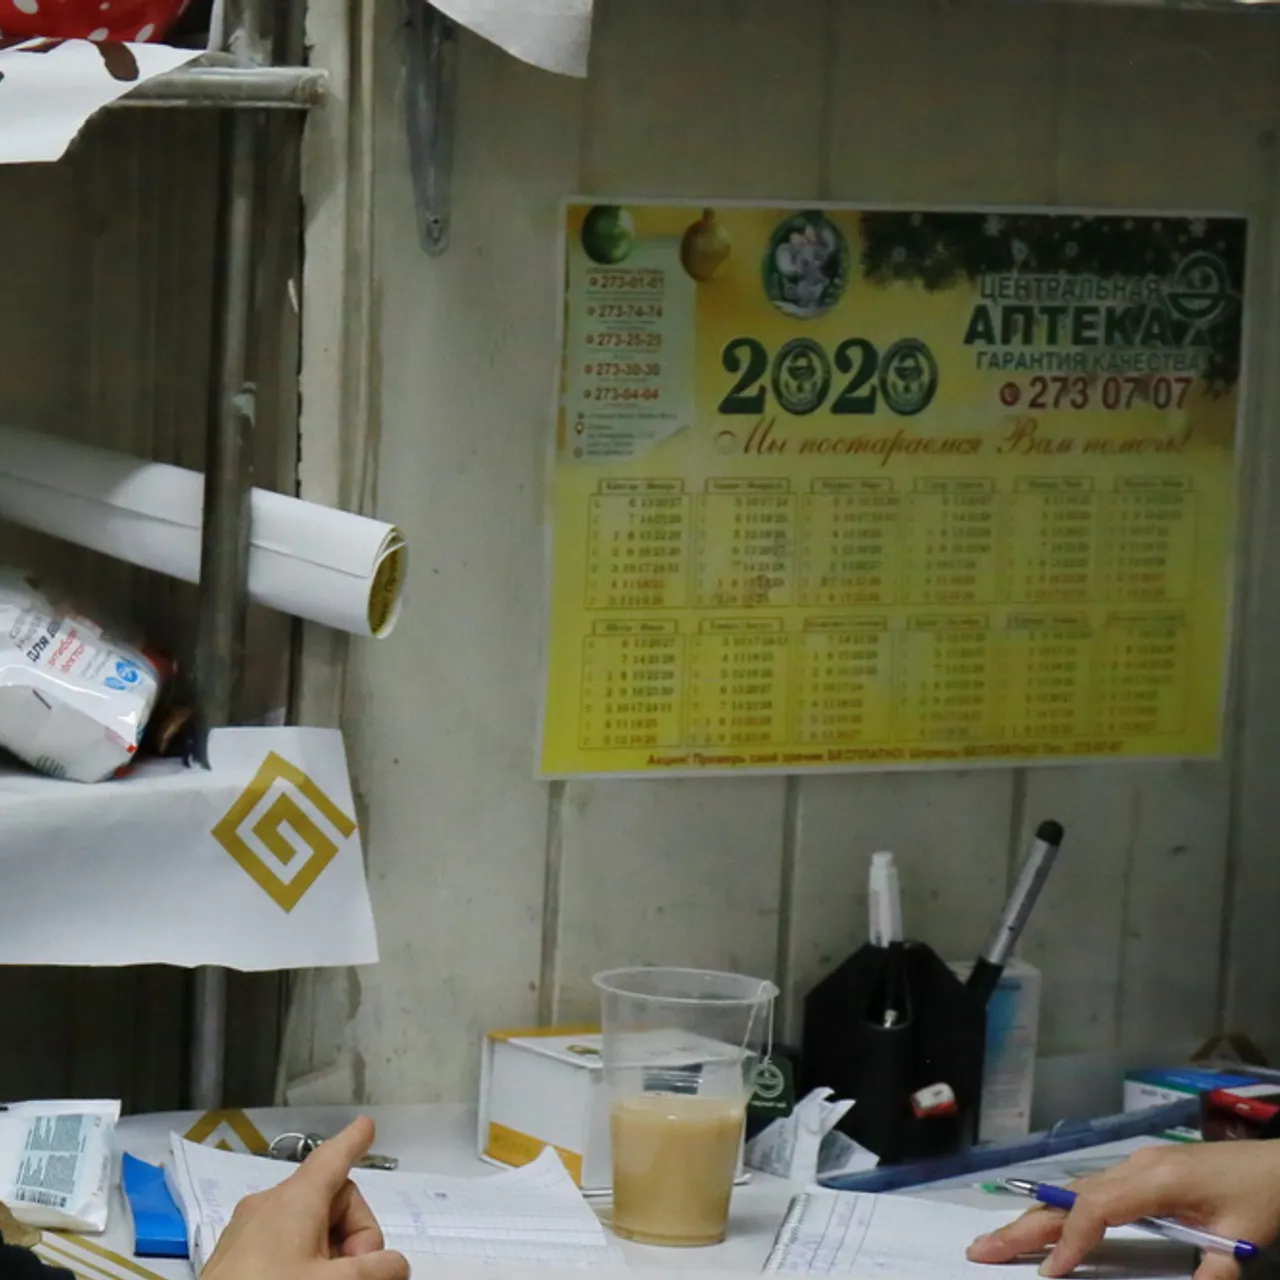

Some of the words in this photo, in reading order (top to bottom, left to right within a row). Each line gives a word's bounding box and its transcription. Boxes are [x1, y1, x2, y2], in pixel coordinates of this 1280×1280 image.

[979, 276, 1161, 303] ЦЕНТРАЛЬНАЯ
[963, 303, 1172, 346] АПТЕКА
[717, 337, 939, 416] 2020
[976, 351, 1086, 371] ГАРАНТИЯ
[1091, 351, 1202, 372] КАЧЕСТВА
[1028, 375, 1090, 410] 273
[1101, 375, 1140, 410] 07
[1151, 375, 1194, 410] 07
[716, 416, 787, 456] Мы
[799, 427, 983, 467] постараемся
[998, 413, 1074, 456] Вам
